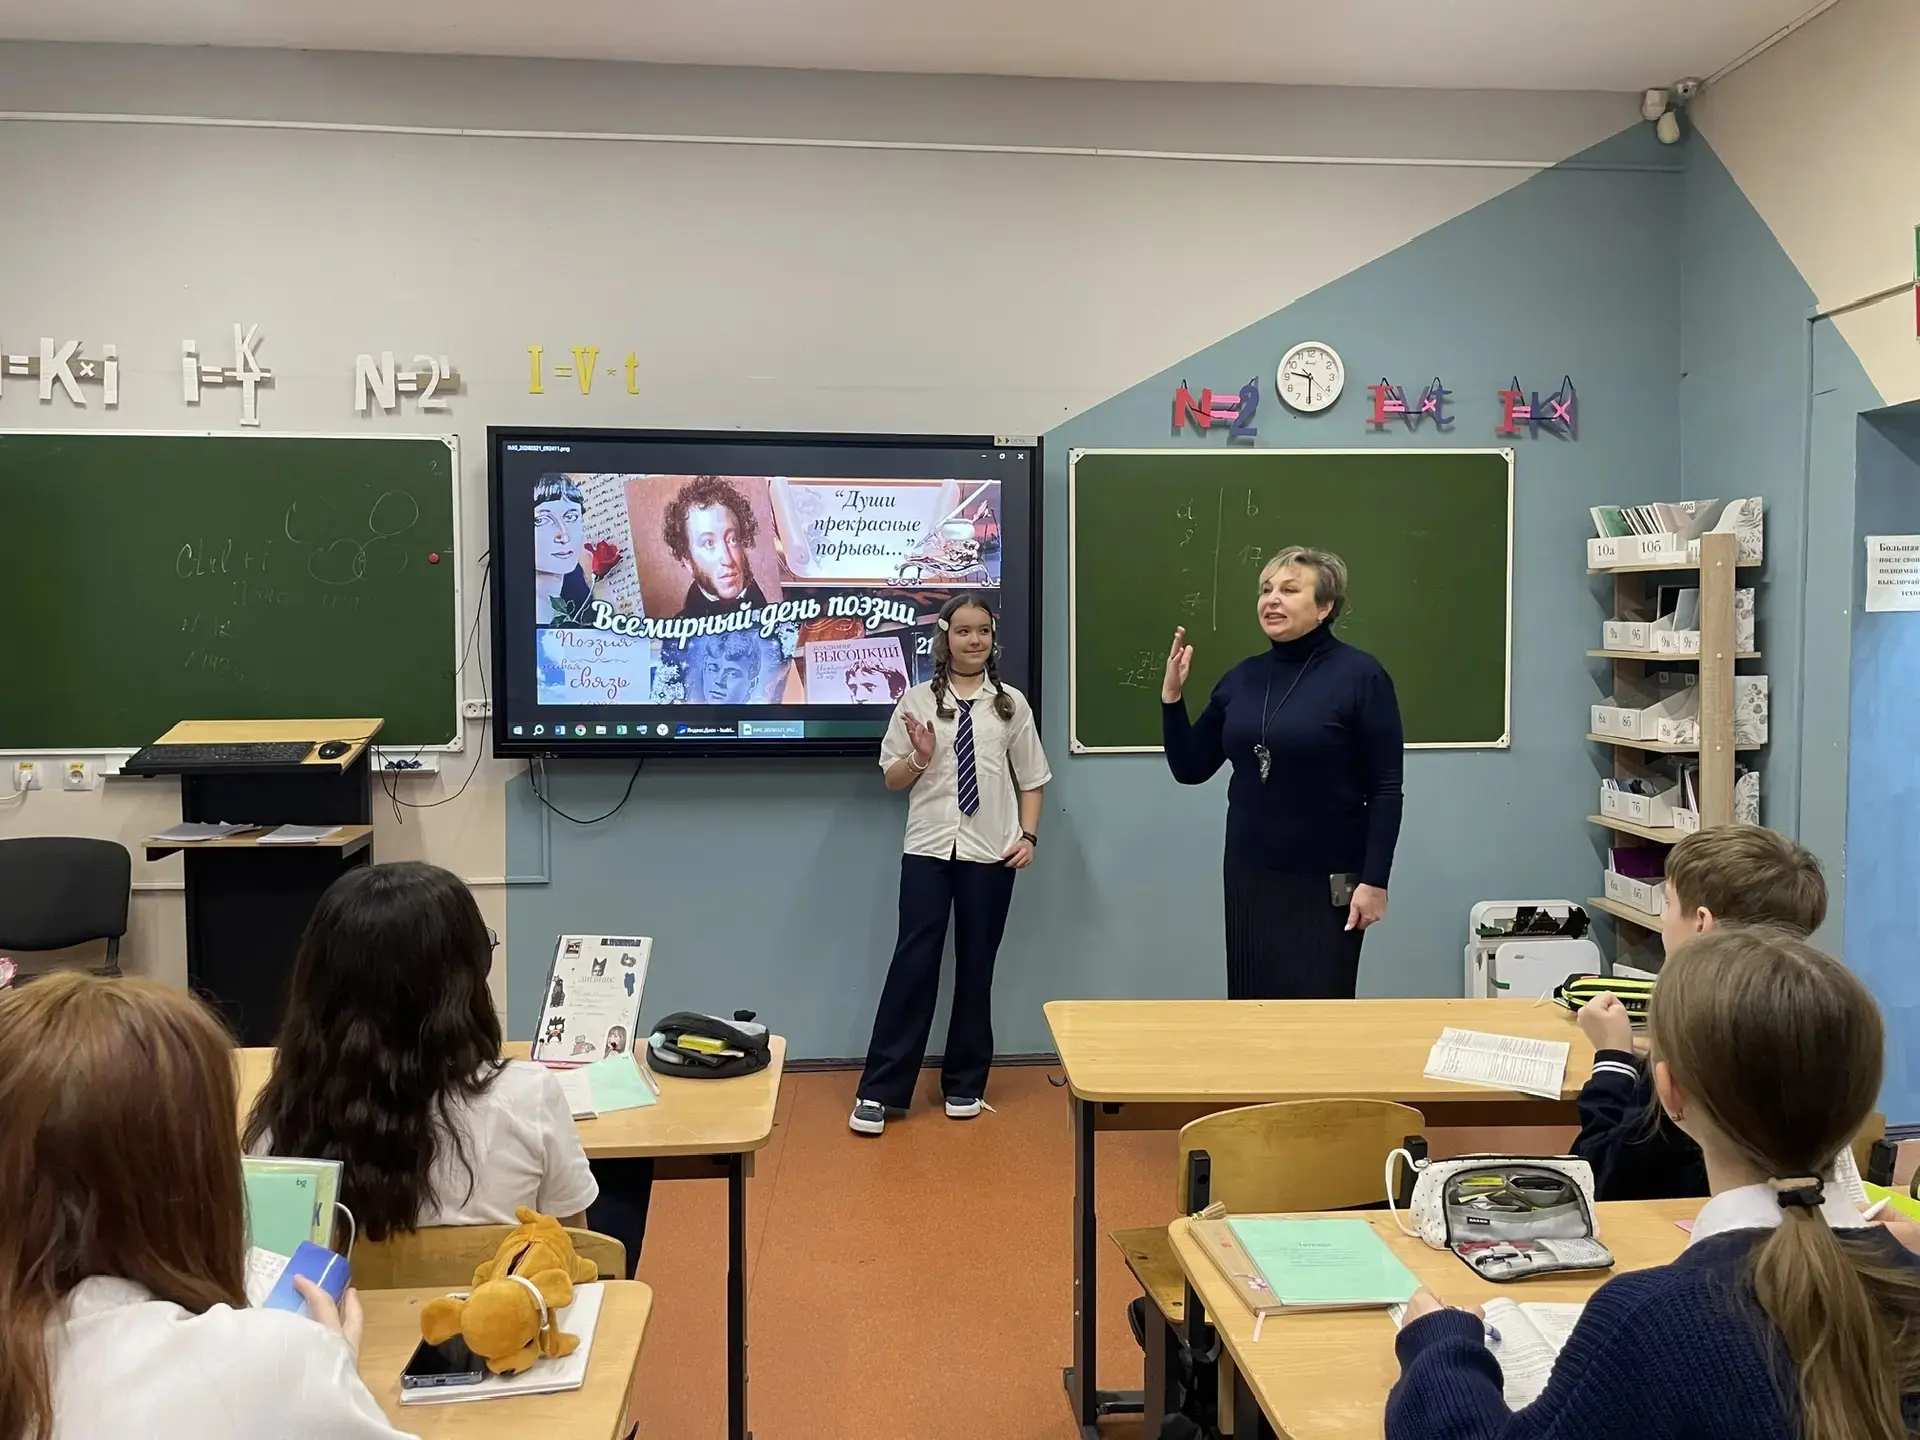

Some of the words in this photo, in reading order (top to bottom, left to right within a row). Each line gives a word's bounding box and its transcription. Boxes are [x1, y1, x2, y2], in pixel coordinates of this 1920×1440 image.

[814, 516, 921, 537] прекрасные
[1597, 543, 1615, 557] 10а
[1641, 540, 1662, 554] 10б
[591, 600, 753, 650] Всемирный
[759, 598, 821, 638] день
[827, 595, 917, 630] поэзии
[814, 644, 900, 664] ВЫСОЦКИЙ
[570, 666, 631, 700] связь
